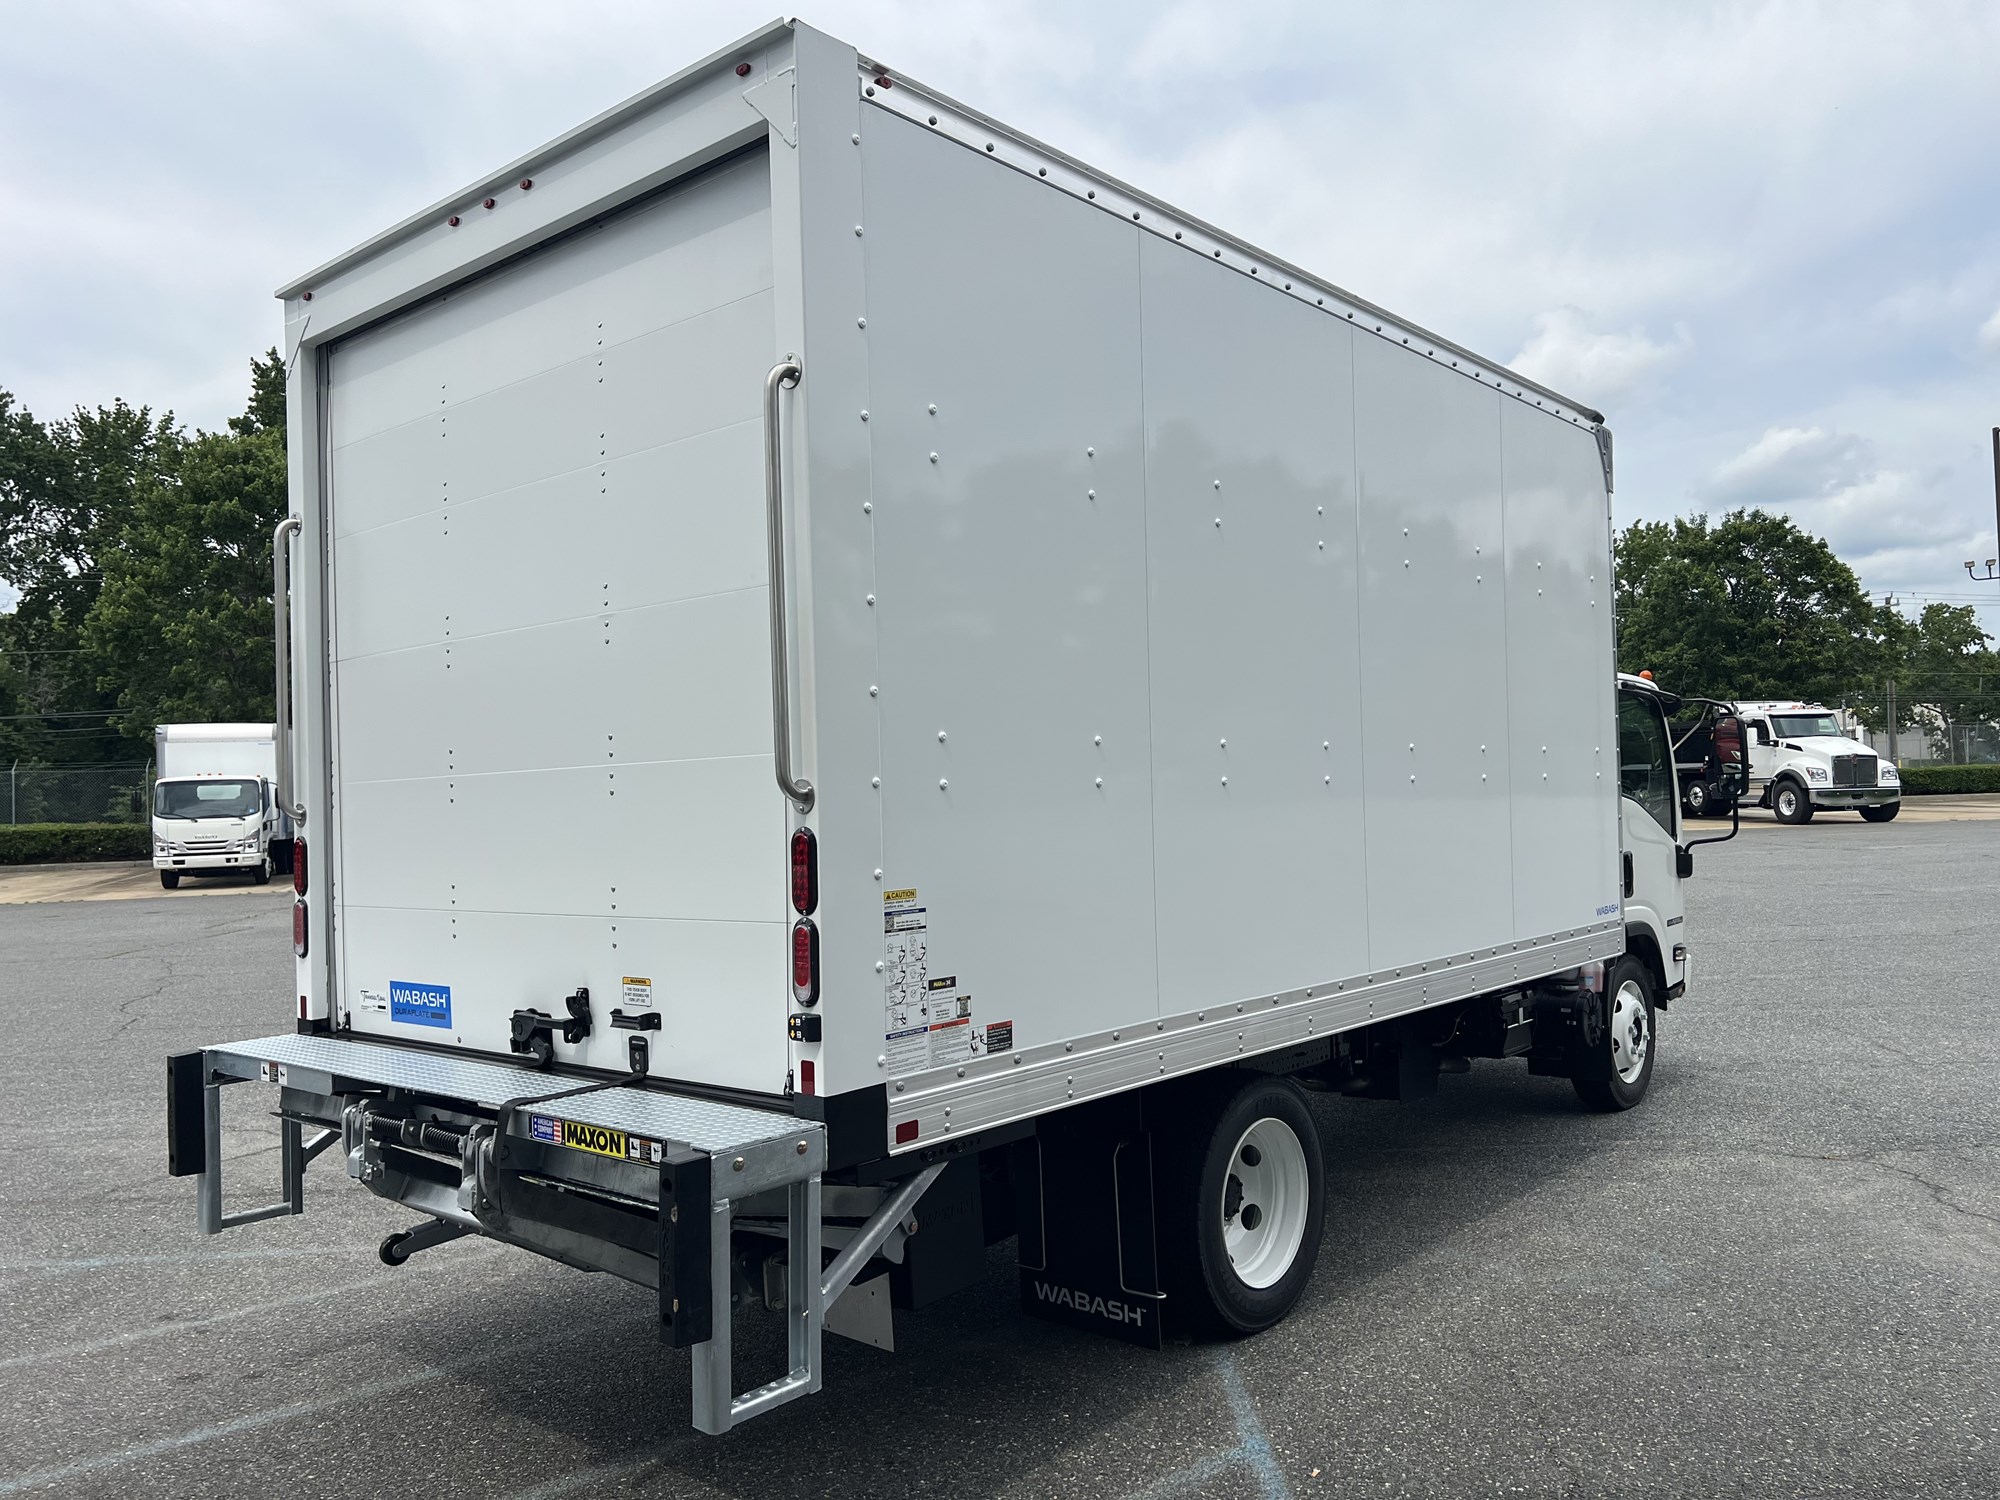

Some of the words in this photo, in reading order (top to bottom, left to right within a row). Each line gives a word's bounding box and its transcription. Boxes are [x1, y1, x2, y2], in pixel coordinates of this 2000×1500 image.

[891, 890, 915, 899] CAUTION
[1596, 904, 1619, 917] WABASH
[392, 988, 447, 1009] WABASH
[394, 1007, 430, 1019] DURAPLATE
[566, 1123, 622, 1154] MAXON
[1034, 1280, 1143, 1327] WABASH
